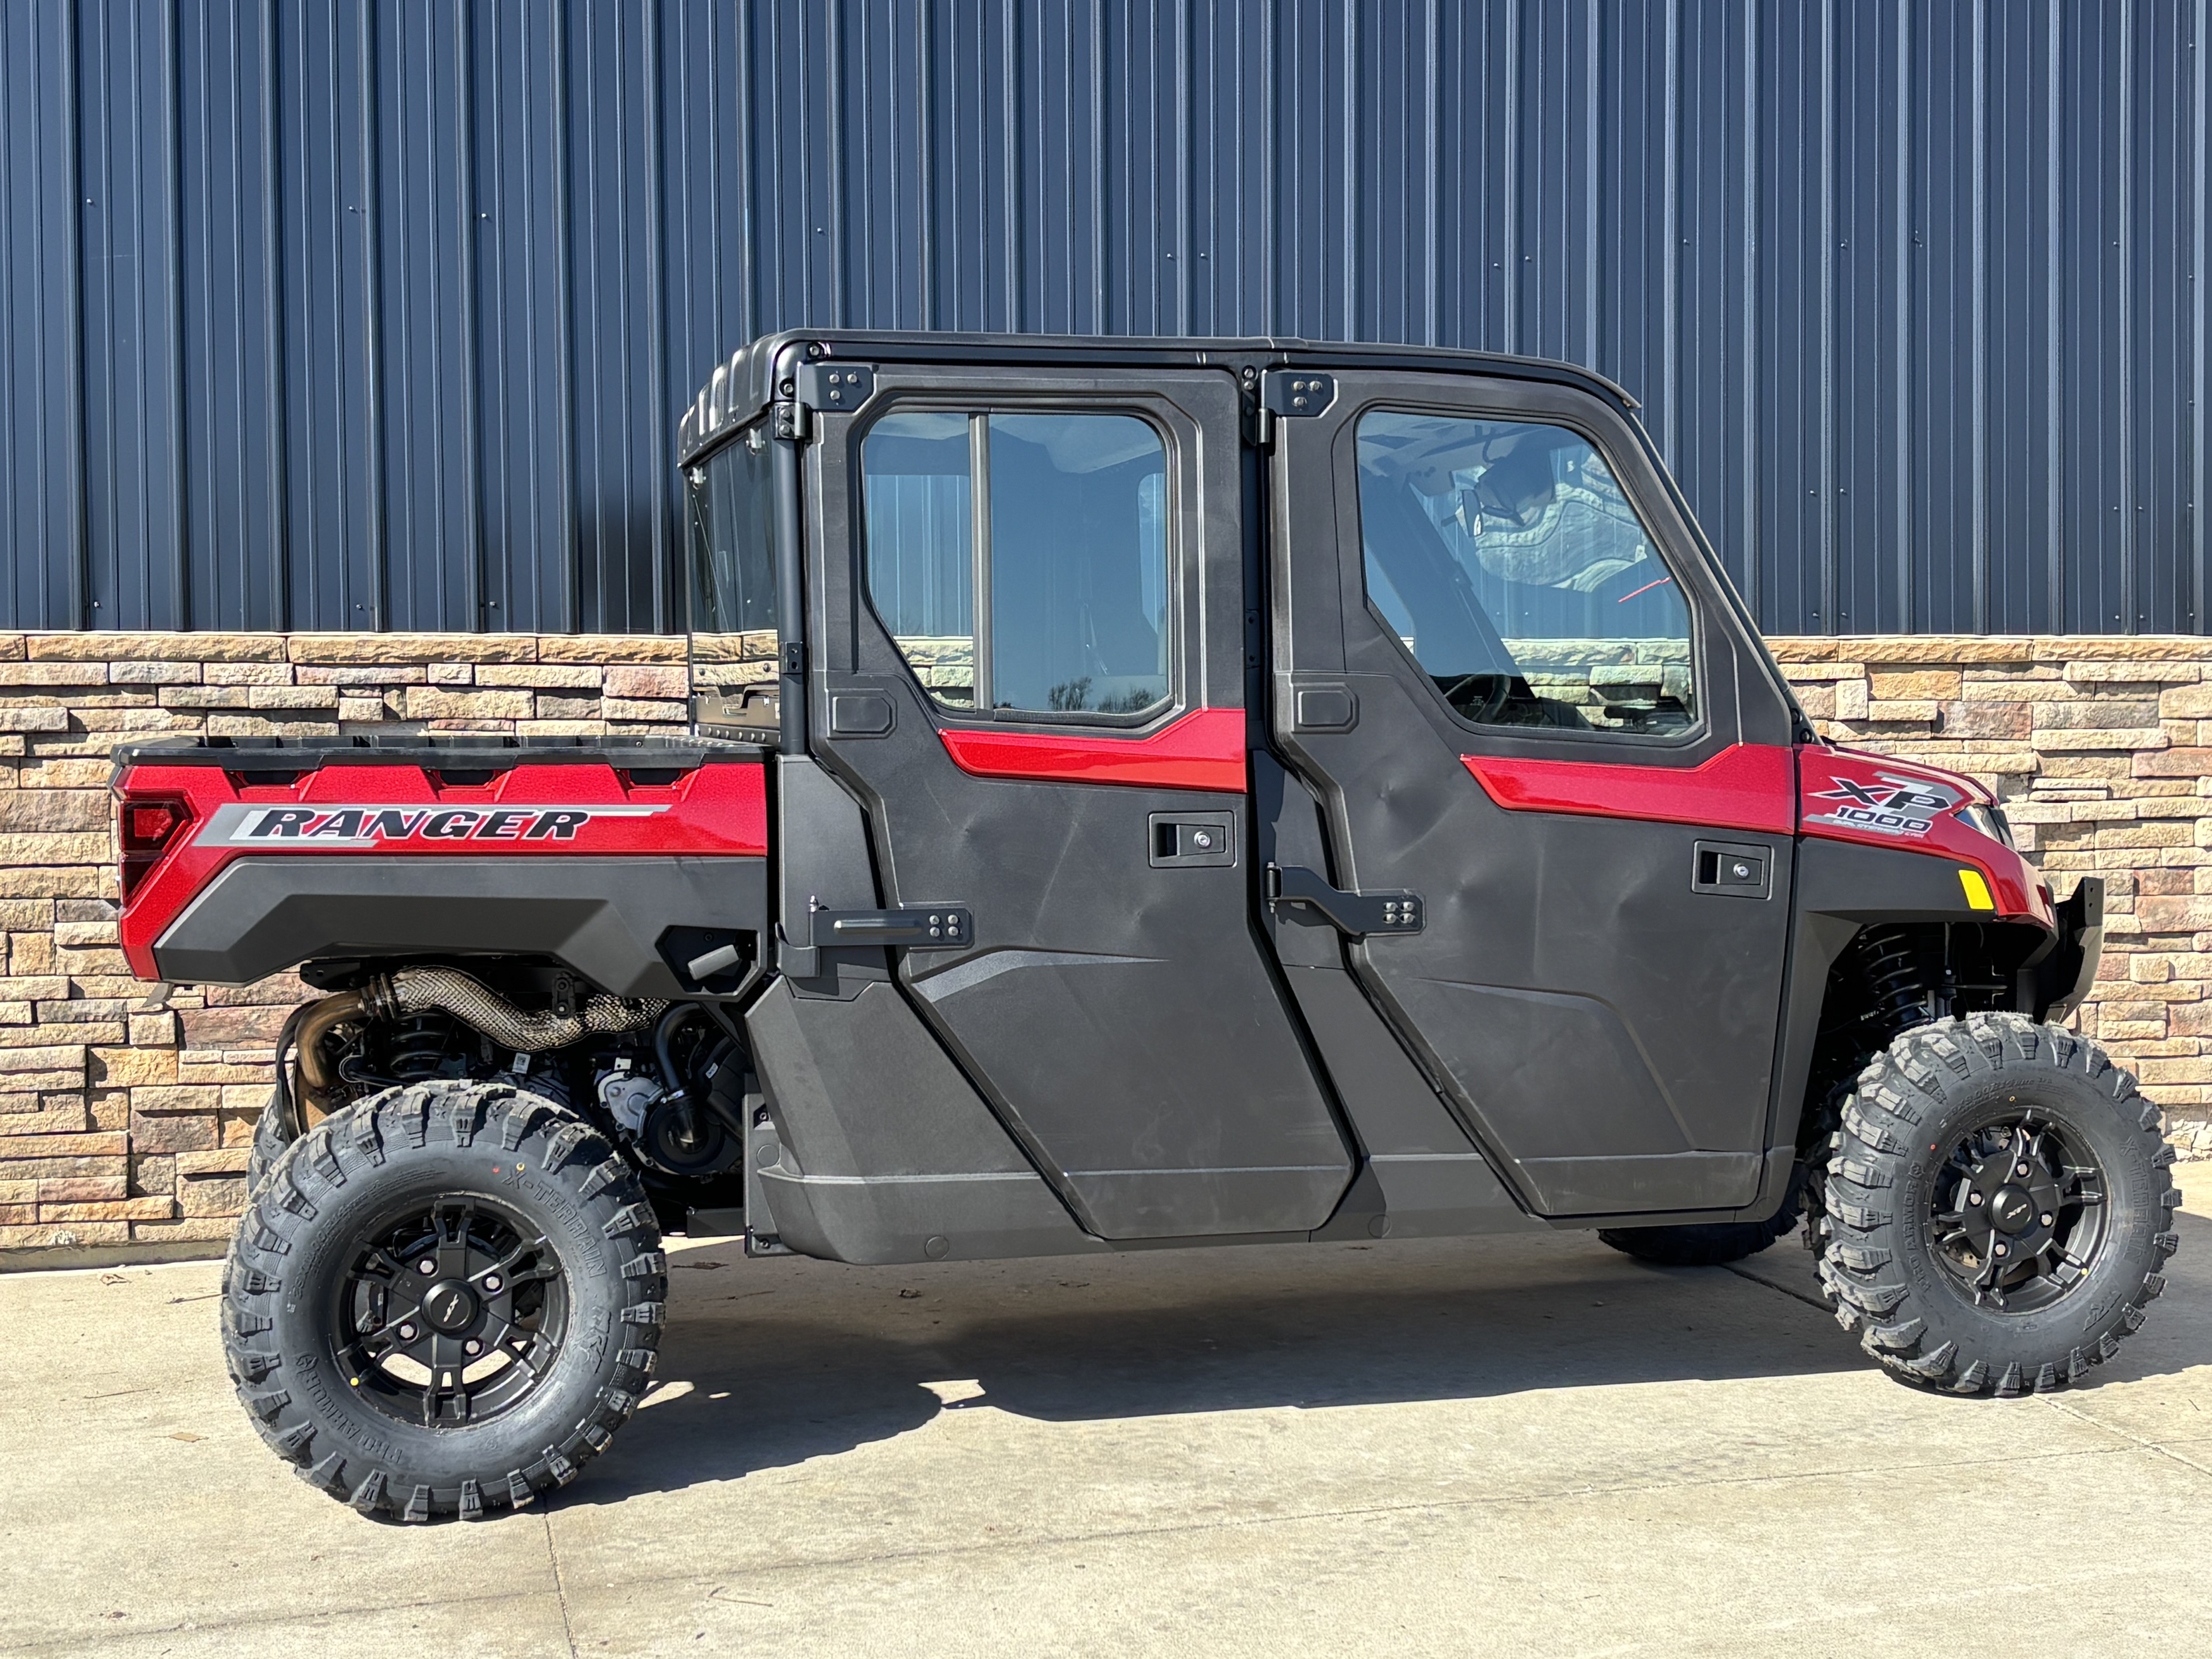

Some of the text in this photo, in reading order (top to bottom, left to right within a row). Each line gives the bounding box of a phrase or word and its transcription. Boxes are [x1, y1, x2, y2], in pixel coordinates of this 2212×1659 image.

[247, 807, 590, 841] RANGER
[1807, 776, 1953, 811] XP
[1836, 805, 1933, 833] 1000
[501, 1166, 607, 1278] X-TERRAIN
[1903, 1180, 1917, 1250] ARMOR
[2119, 1135, 2149, 1264] X-TERRAIN
[307, 1369, 403, 1464] PRO ARMOR
